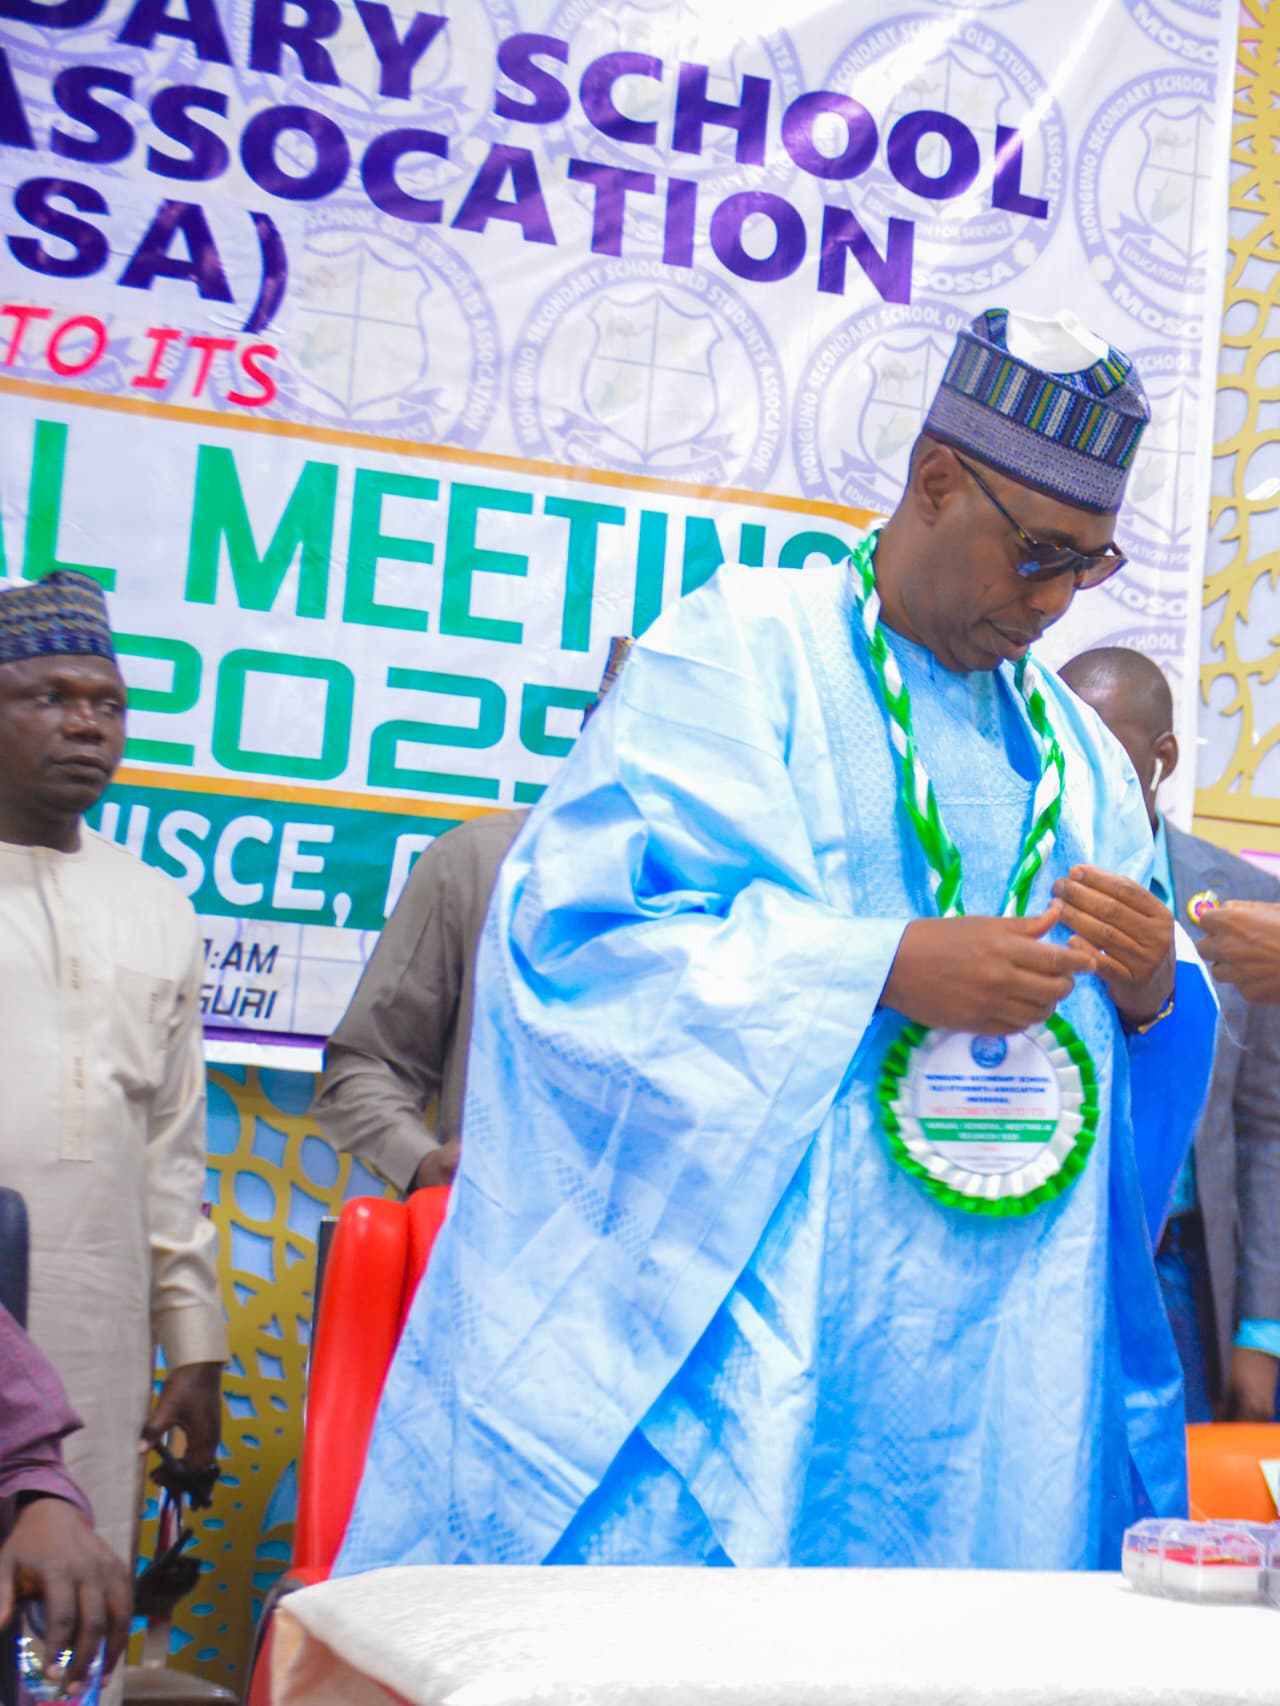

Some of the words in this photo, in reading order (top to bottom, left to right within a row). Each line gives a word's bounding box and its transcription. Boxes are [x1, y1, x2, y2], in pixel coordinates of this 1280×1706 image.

[1087, 81, 1152, 152] SECONDARY
[1153, 75, 1211, 95] SCHOOL
[493, 32, 1049, 220] SCHOOL
[1078, 153, 1100, 245] MONGUNO
[526, 266, 602, 344] SECONDARY
[604, 259, 673, 281] SCHOOL
[674, 267, 709, 291] OLD
[880, 305, 942, 326] SCHOOL
[912, 262, 1017, 293] SOSSA
[0, 303, 109, 378] TO
[130, 326, 280, 409] ITS
[807, 314, 880, 388] SECONDARY
[1134, 353, 1194, 374] SCHOOL
[797, 391, 822, 486] MONGUNO
[0, 418, 118, 593] L
